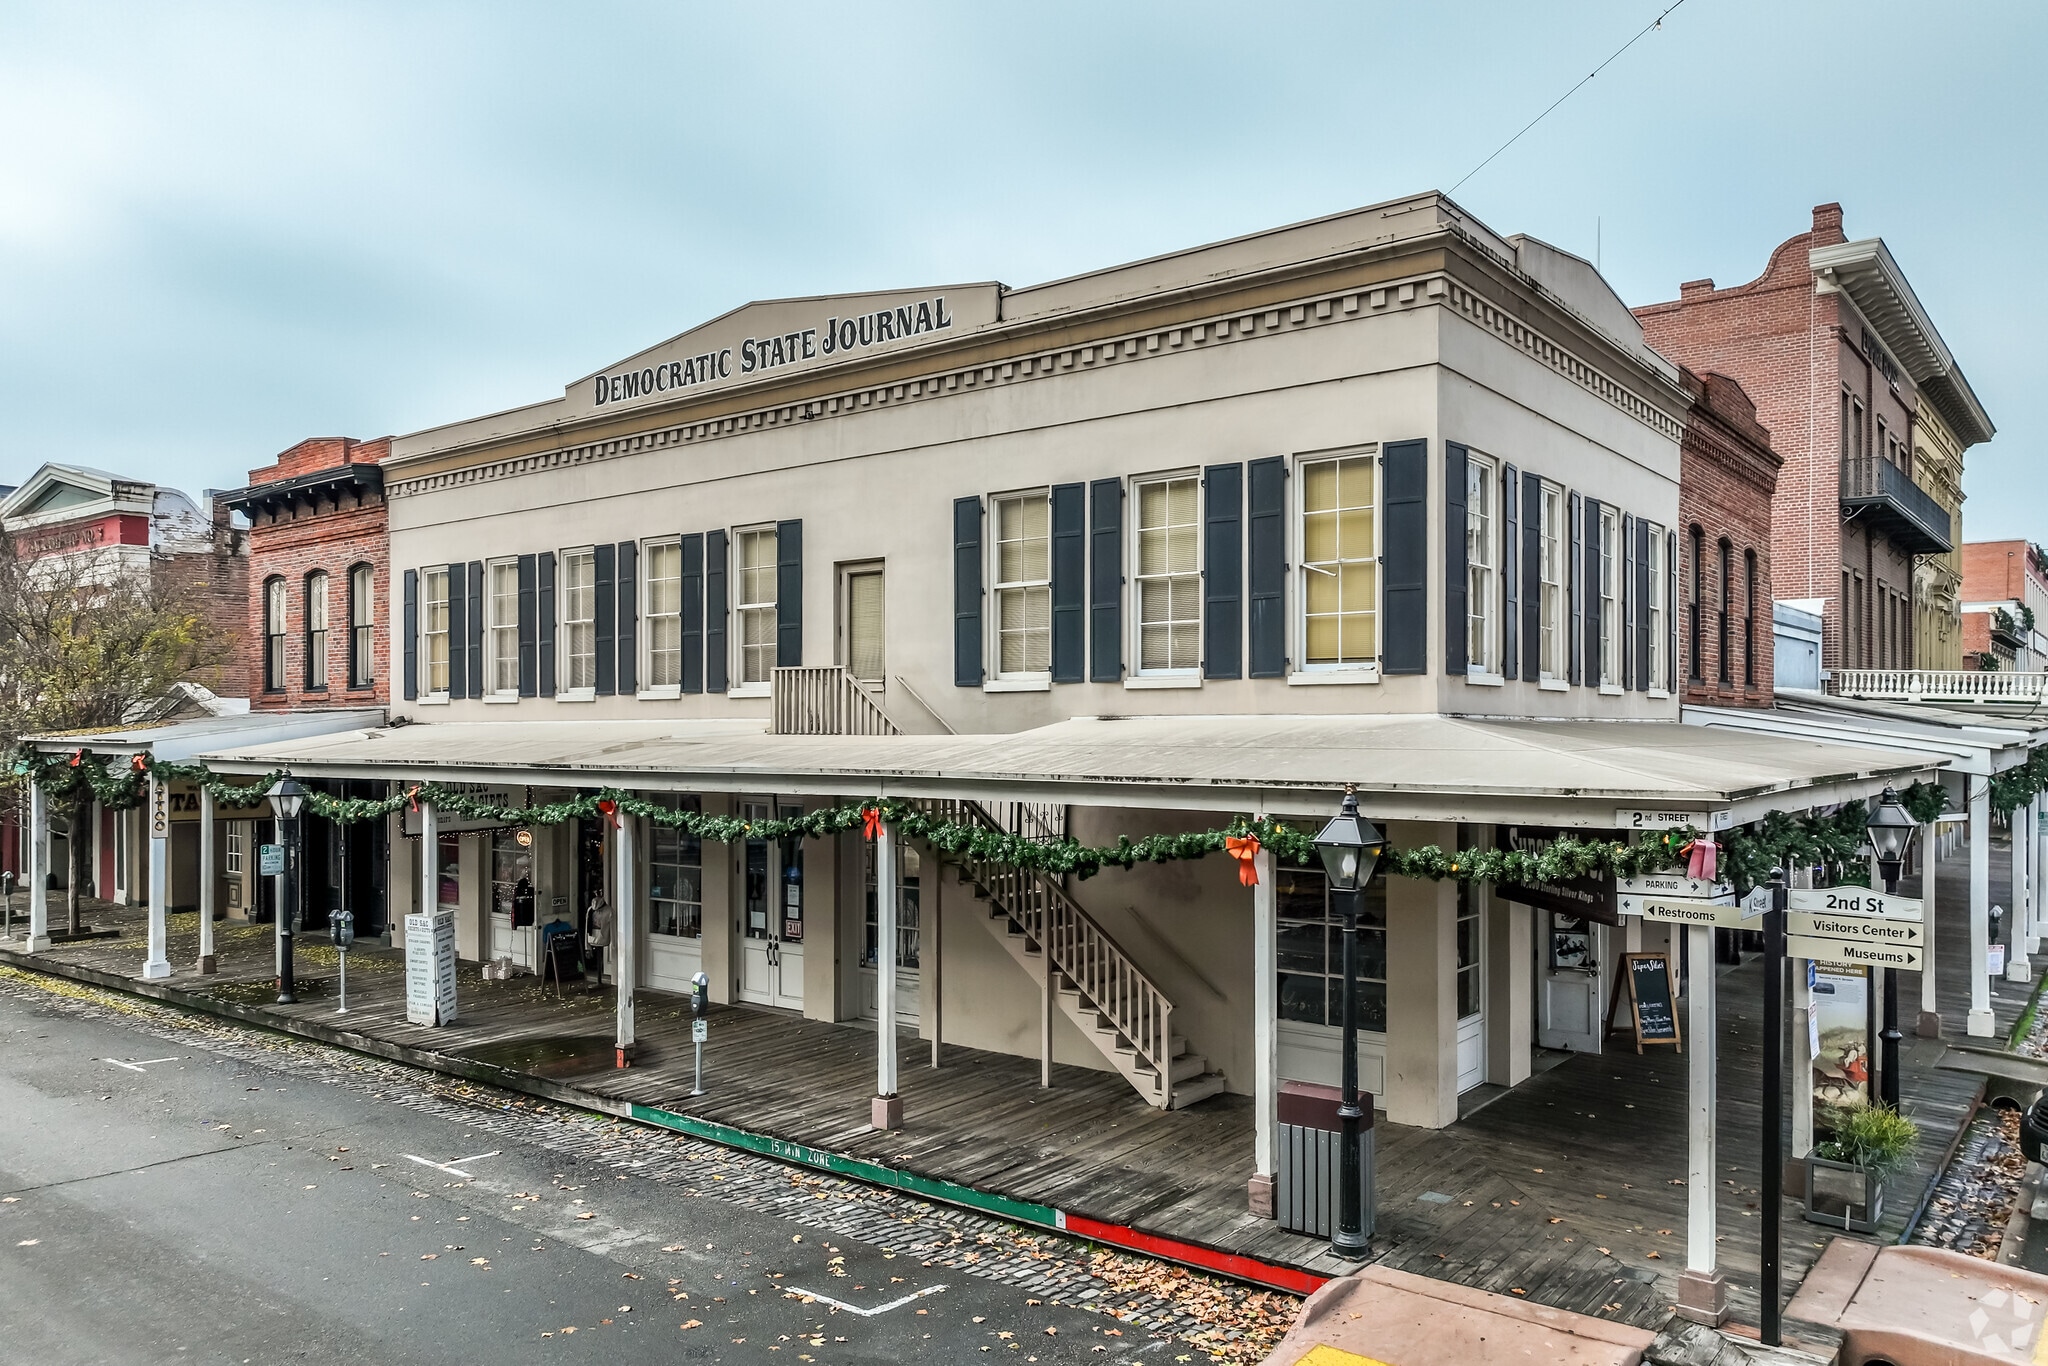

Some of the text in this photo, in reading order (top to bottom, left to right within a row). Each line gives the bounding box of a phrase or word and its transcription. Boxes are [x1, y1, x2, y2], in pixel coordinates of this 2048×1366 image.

[593, 295, 954, 408] DEMOCRATIC STATE JOURNAL
[154, 781, 166, 831] ATTOO
[1657, 813, 1690, 823] STREET
[262, 846, 269, 854] 2
[1645, 880, 1679, 890] PARKING
[1561, 886, 1578, 899] Silver
[1578, 890, 1594, 904] Rings
[1826, 894, 1884, 913] 2nd St
[1658, 906, 1716, 921] Restrooms
[787, 922, 801, 934] EXIT
[1813, 920, 1904, 938] Visitors Center
[1844, 946, 1904, 963] Museums
[1820, 959, 1852, 968] HISTORY
[771, 1140, 780, 1153] 15
[807, 1150, 831, 1167] ZONE
